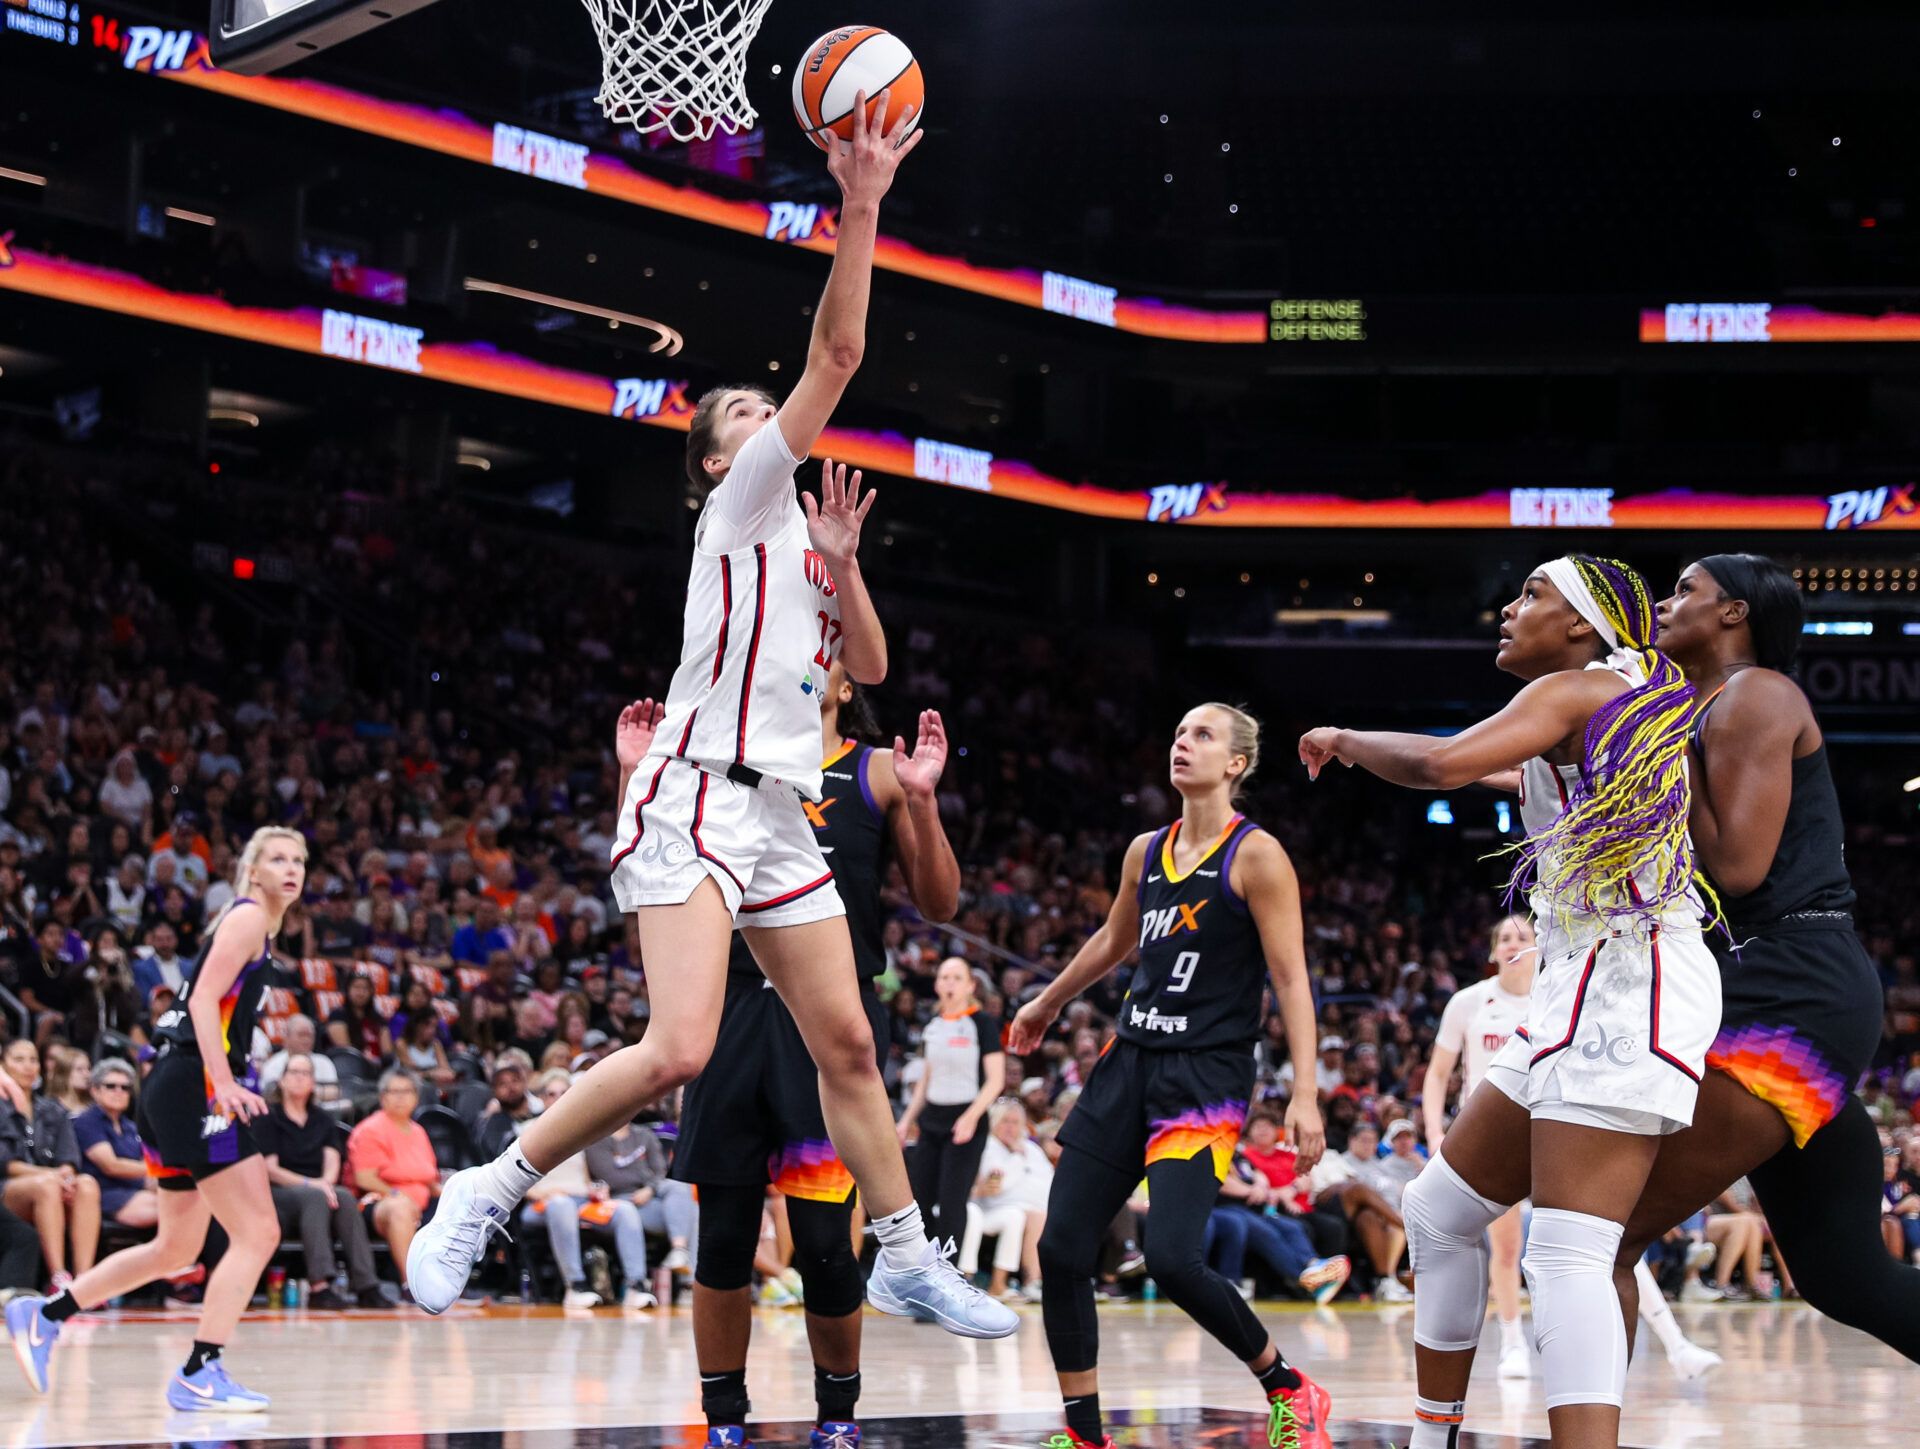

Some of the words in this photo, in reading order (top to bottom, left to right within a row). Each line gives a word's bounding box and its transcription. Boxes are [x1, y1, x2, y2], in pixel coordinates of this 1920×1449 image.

[491, 122, 590, 189] DEFENSE
[320, 308, 424, 373] DEFENSE
[1665, 303, 1772, 342] DEFENSE
[611, 378, 690, 418] PHX
[914, 438, 994, 492] DEFENSE
[1147, 480, 1228, 522] PHX
[1510, 488, 1615, 528] DEFENSE
[1824, 482, 1916, 530] PHX
[1139, 899, 1209, 948] PHX
[1166, 951, 1200, 993] 9
